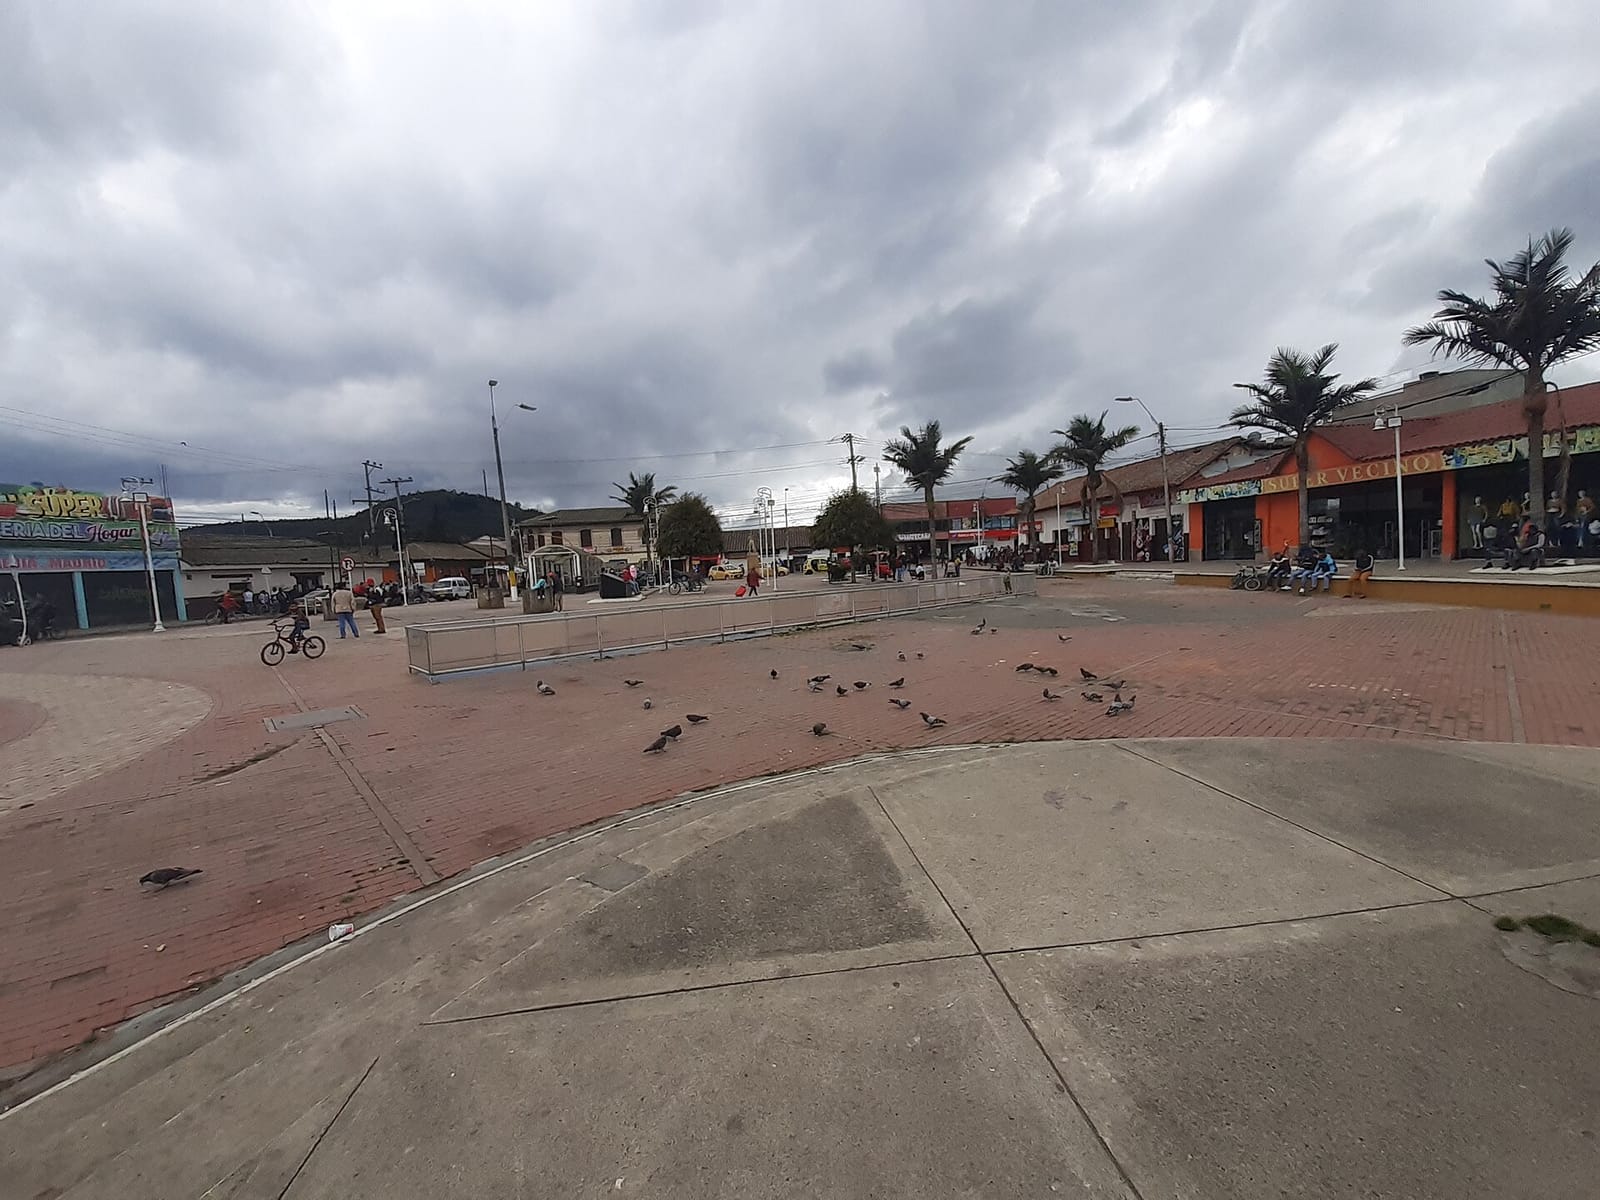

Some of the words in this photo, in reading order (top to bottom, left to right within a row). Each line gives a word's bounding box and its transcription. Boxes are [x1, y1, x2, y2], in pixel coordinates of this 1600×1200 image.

[1269, 472, 1329, 490] SUR
[1336, 456, 1430, 482] VECINO
[25, 488, 102, 518] SUPER
[48, 522, 88, 539] DEL
[86, 524, 137, 543] Hogar
